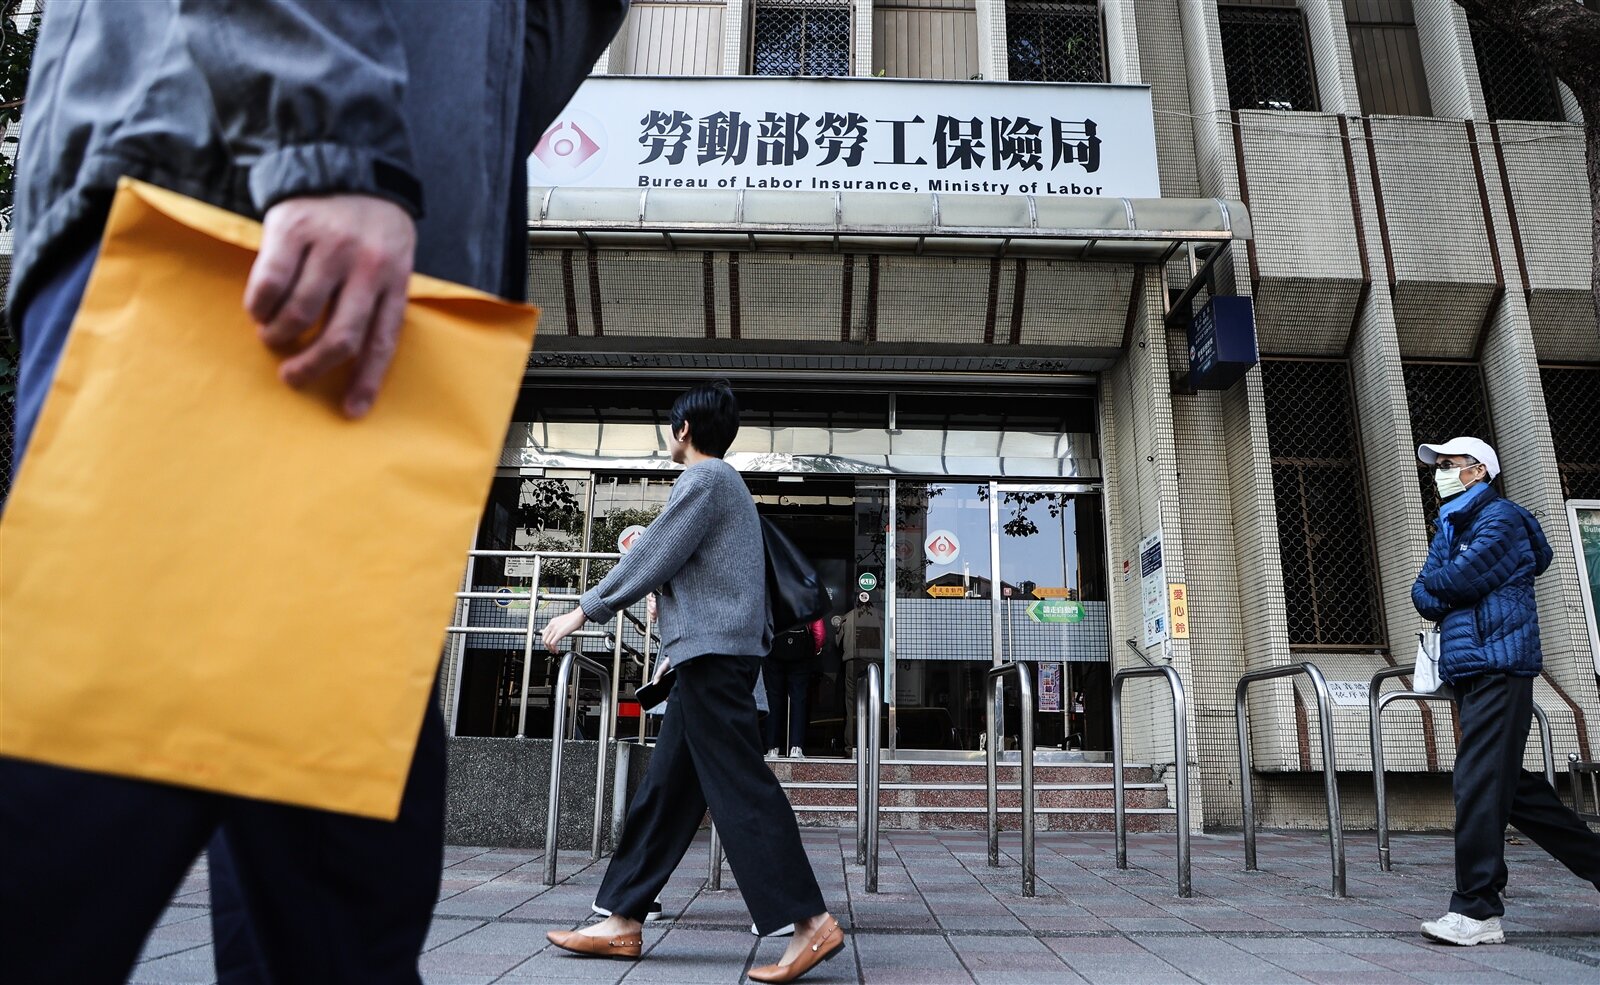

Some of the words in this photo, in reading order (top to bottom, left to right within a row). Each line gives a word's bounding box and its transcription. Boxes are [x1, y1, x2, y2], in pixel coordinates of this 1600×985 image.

[638, 110, 1103, 173] 勞動部勞工保險局
[638, 175, 708, 188] Bureau
[717, 176, 737, 188] of
[745, 176, 803, 189] Labor
[812, 177, 919, 193] Insurance,
[928, 179, 1010, 196] Ministry
[1019, 182, 1038, 194] of
[1047, 182, 1103, 196] Labor
[1173, 589, 1186, 634] 愛心鈴
